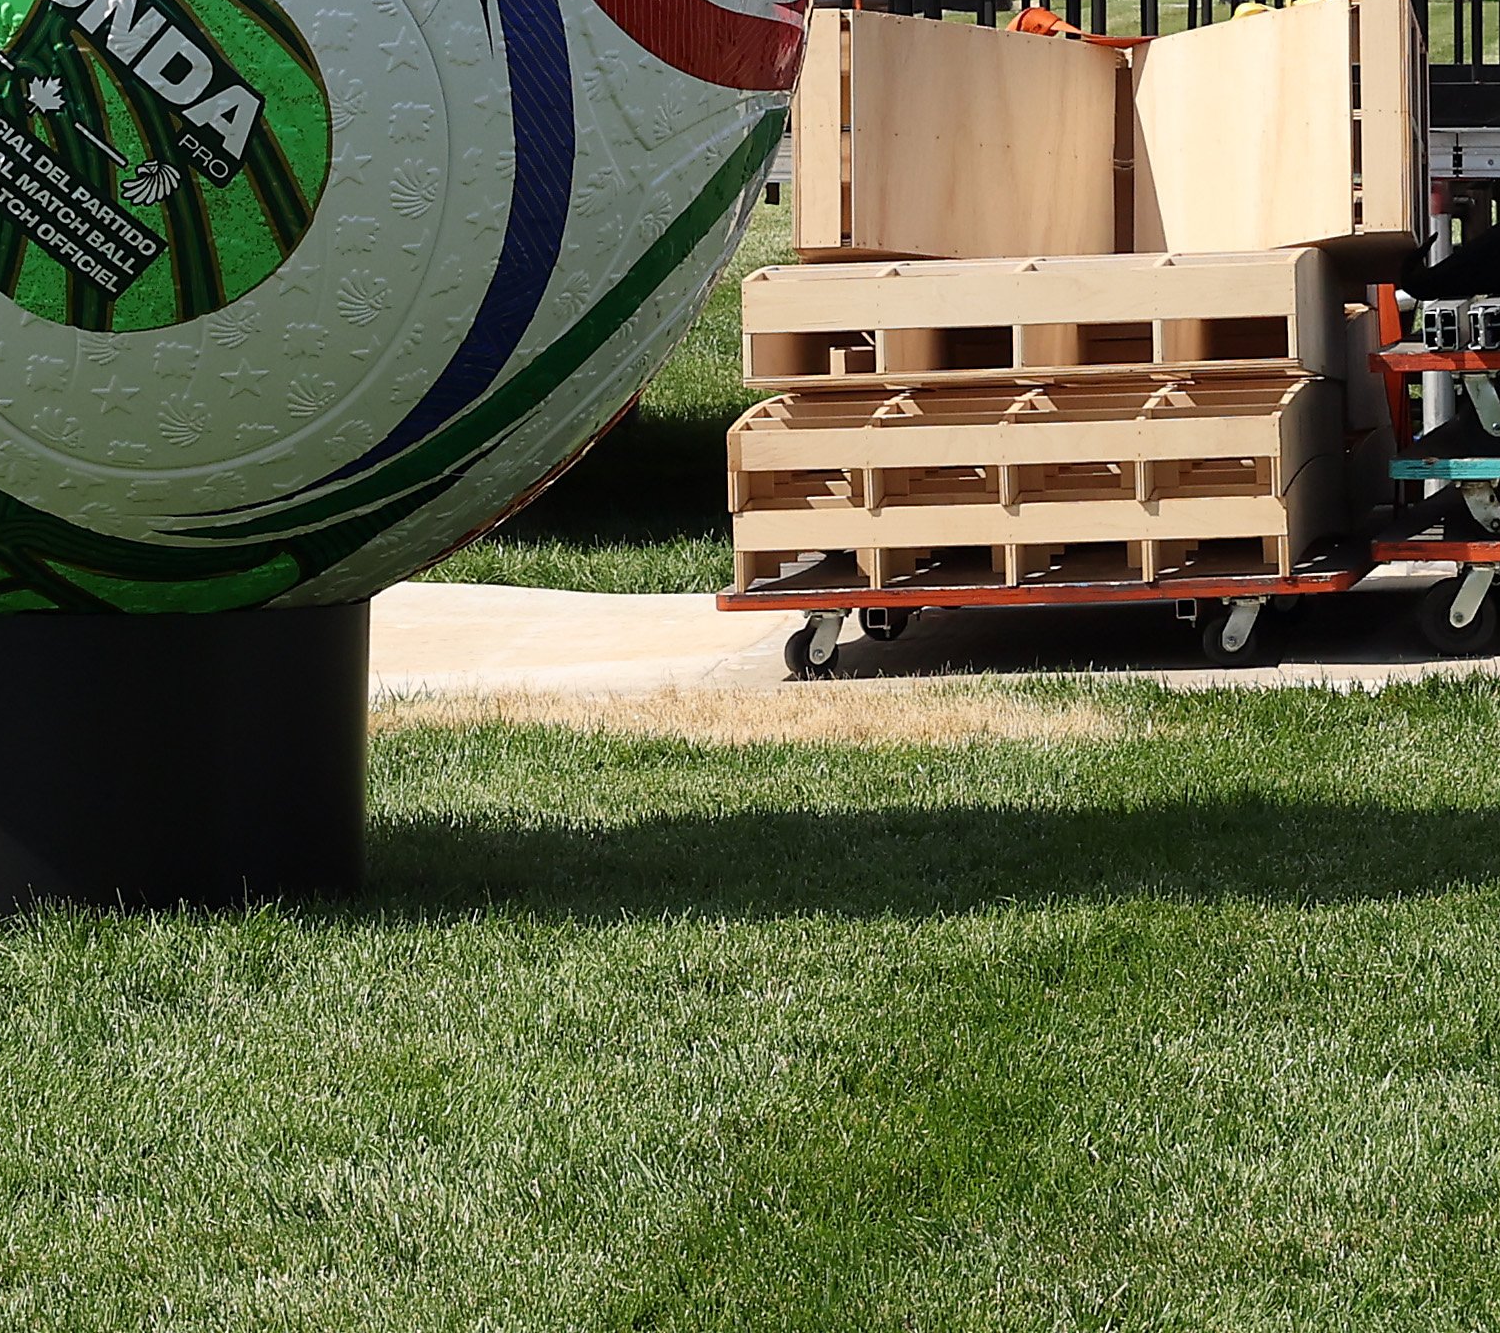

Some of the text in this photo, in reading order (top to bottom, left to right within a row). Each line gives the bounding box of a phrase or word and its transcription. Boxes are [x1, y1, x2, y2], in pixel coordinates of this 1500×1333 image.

[178, 133, 229, 180] PRO
[14, 173, 92, 236] MATCH
[85, 226, 136, 275] BALL
[34, 155, 71, 193] DEL
[71, 185, 157, 257] PARTIDO
[36, 222, 118, 293] OFFICIEL
